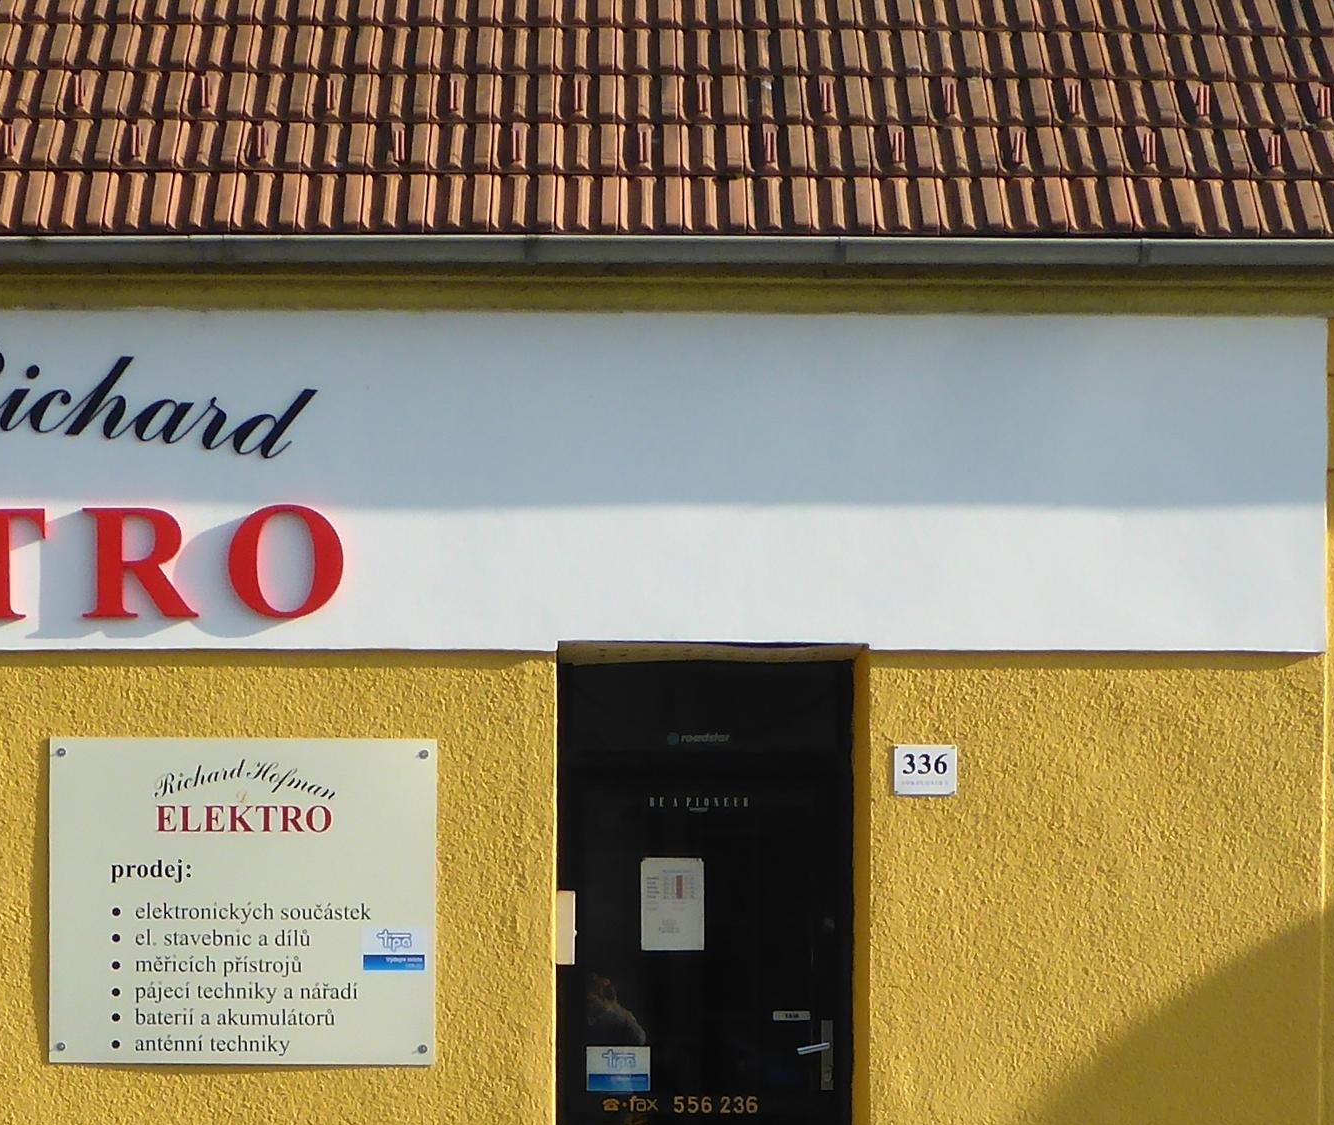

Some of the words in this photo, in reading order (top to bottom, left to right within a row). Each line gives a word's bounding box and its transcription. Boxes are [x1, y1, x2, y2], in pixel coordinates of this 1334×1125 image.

[902, 753, 948, 775] 336
[154, 758, 245, 799] Richard
[246, 761, 336, 801] Hofman
[155, 804, 332, 833] ELEKTRO
[110, 857, 192, 884] prodej:
[135, 901, 274, 924] elektronických
[280, 902, 372, 921] součástek
[135, 928, 158, 947] el.
[163, 928, 252, 947] stavebnic
[258, 934, 268, 947] a
[274, 928, 310, 947] dílů
[377, 929, 412, 952] tipa
[135, 954, 216, 974] měřicích
[223, 953, 302, 978] přístrojů
[135, 981, 190, 1004] pájecí
[197, 981, 277, 1005] techniky
[283, 987, 294, 1000] a
[300, 980, 358, 1000] nářadí
[134, 1007, 194, 1026] baterií
[200, 1013, 211, 1026] a
[216, 1006, 335, 1026] akumulátorů
[134, 1034, 203, 1052] anténní
[210, 1034, 290, 1057] techniky
[629, 1095, 658, 1112] fax
[673, 1095, 713, 1114] 556
[720, 1095, 758, 1114] 236
